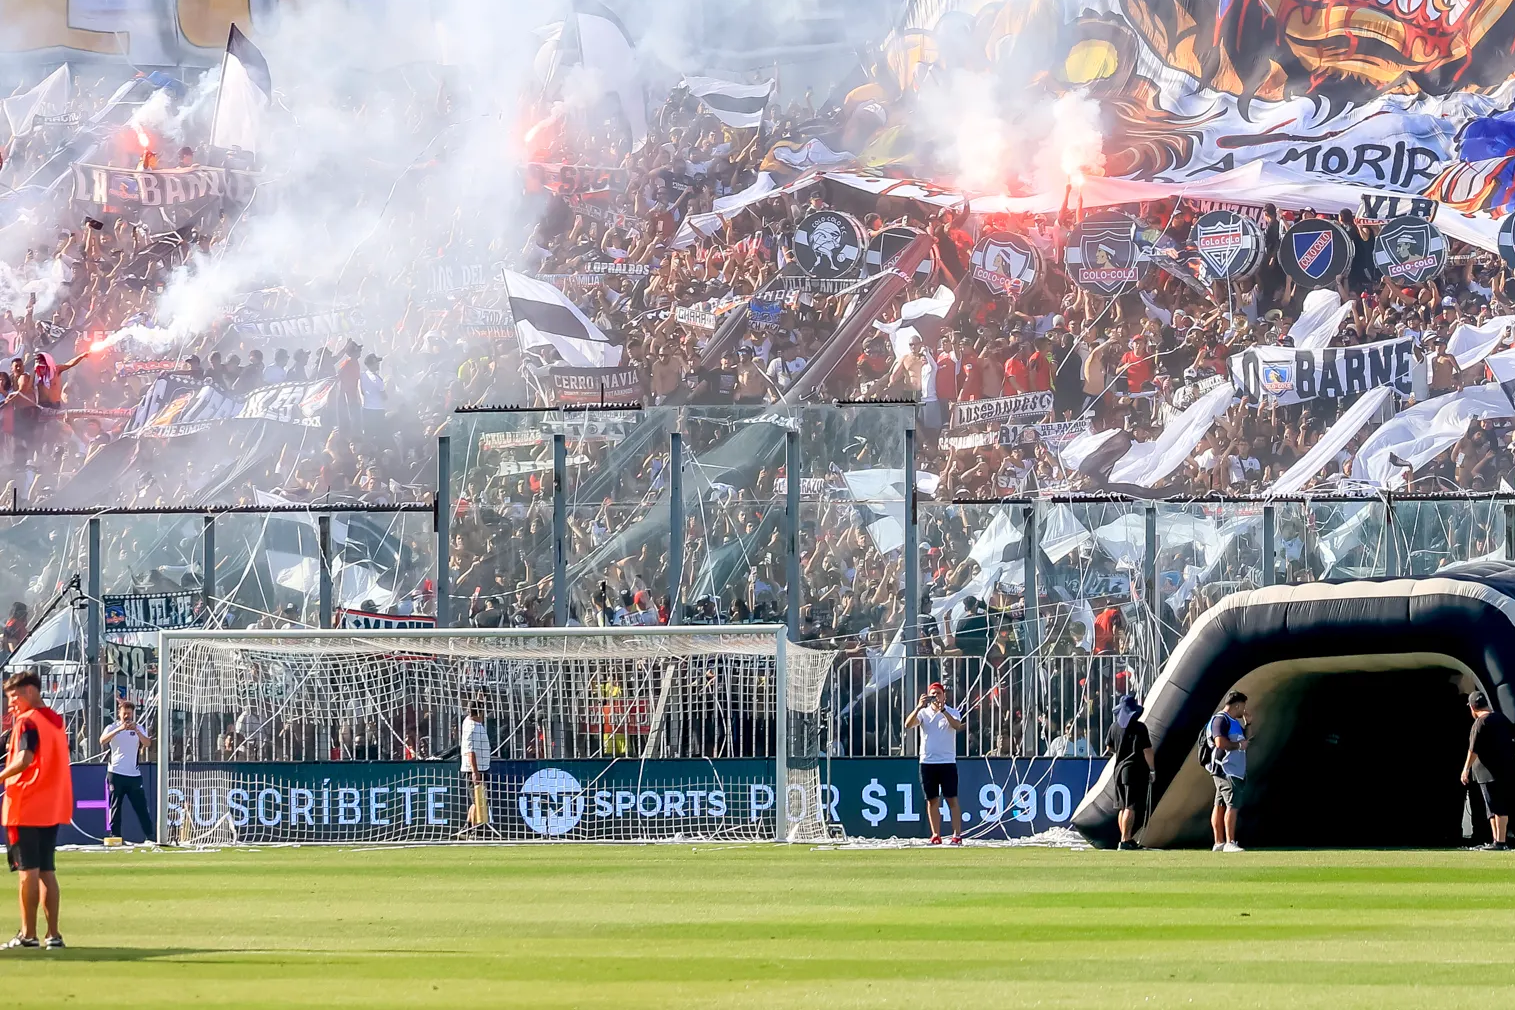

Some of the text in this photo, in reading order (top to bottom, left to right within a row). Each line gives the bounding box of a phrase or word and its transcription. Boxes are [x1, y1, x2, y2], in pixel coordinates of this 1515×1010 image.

[811, 217, 826, 229] COLO
[1301, 233, 1331, 267] COLO COLO
[1392, 257, 1434, 274] COLO-COLO
[1083, 270, 1135, 280] COLO-COLO
[554, 371, 640, 390] CERRO NAVIA
[166, 777, 448, 826] SUSCRÍBETE
[594, 789, 727, 818] SPORTS
[751, 783, 840, 822] POR
